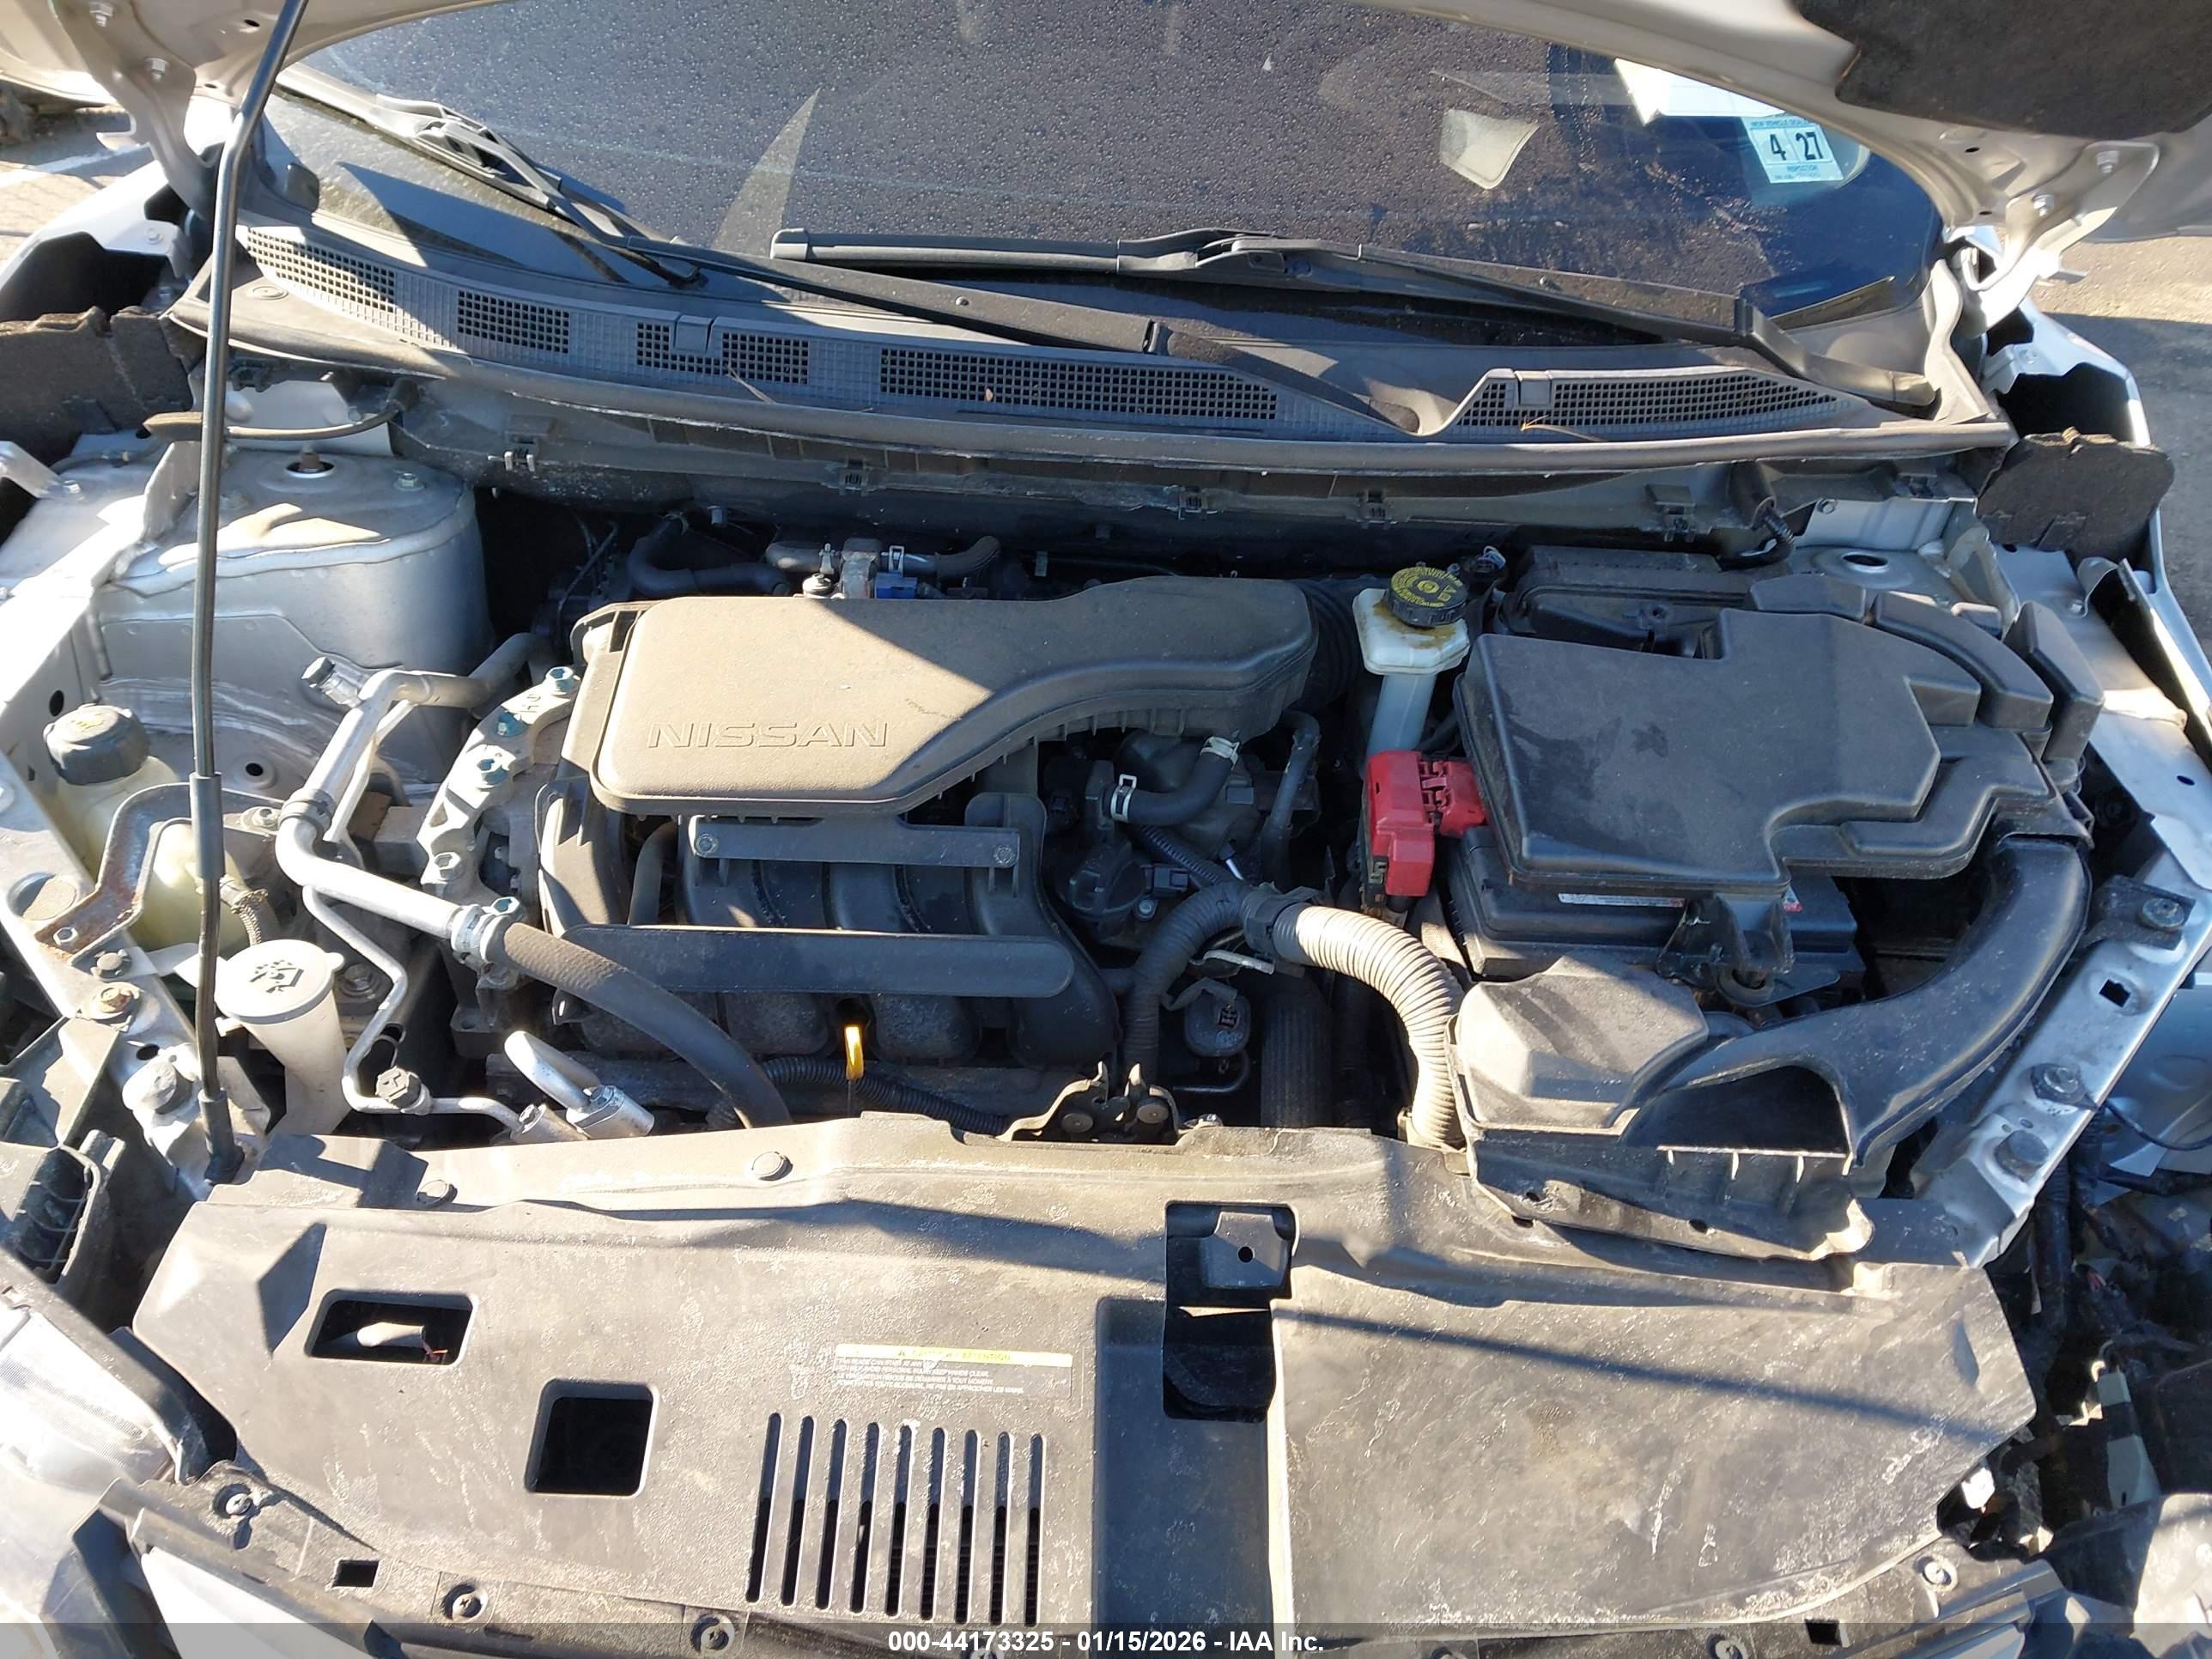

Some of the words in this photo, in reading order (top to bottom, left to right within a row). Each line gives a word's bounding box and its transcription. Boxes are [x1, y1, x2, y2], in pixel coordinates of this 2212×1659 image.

[1769, 134, 1786, 161] 4
[1796, 131, 1824, 161] 27
[647, 722, 888, 748] NISSAN
